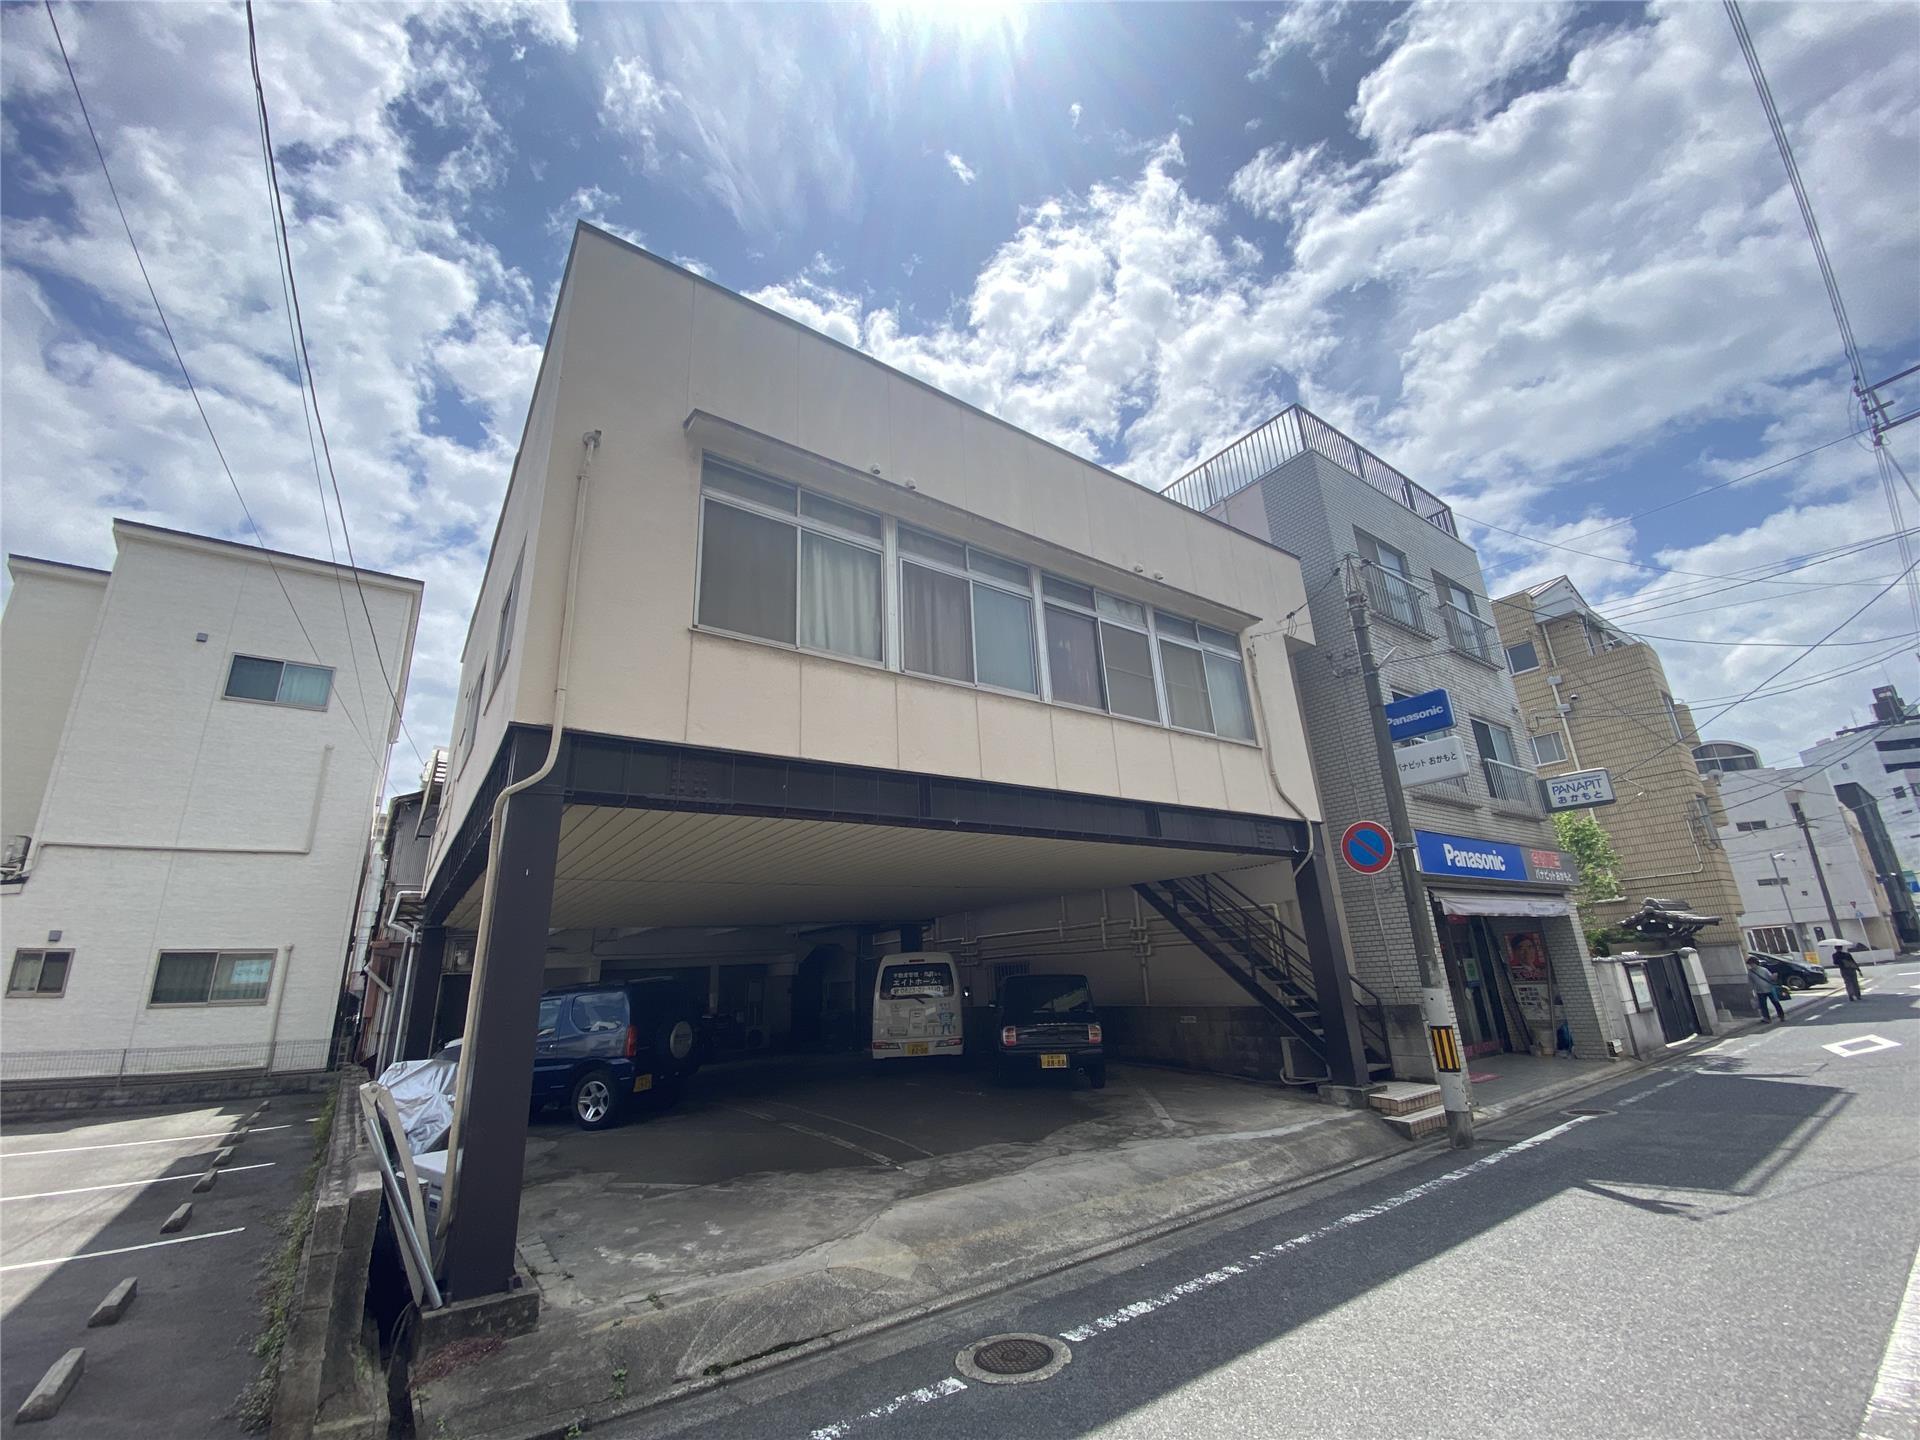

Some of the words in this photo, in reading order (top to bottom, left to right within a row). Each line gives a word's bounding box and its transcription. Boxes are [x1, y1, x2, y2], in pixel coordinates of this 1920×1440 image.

[1387, 705, 1444, 726] Panasonic
[1429, 751, 1457, 766] おかもと
[1552, 778, 1602, 796] PANAPIT
[1557, 790, 1604, 805] おかもと
[1443, 843, 1506, 871] Panasonic
